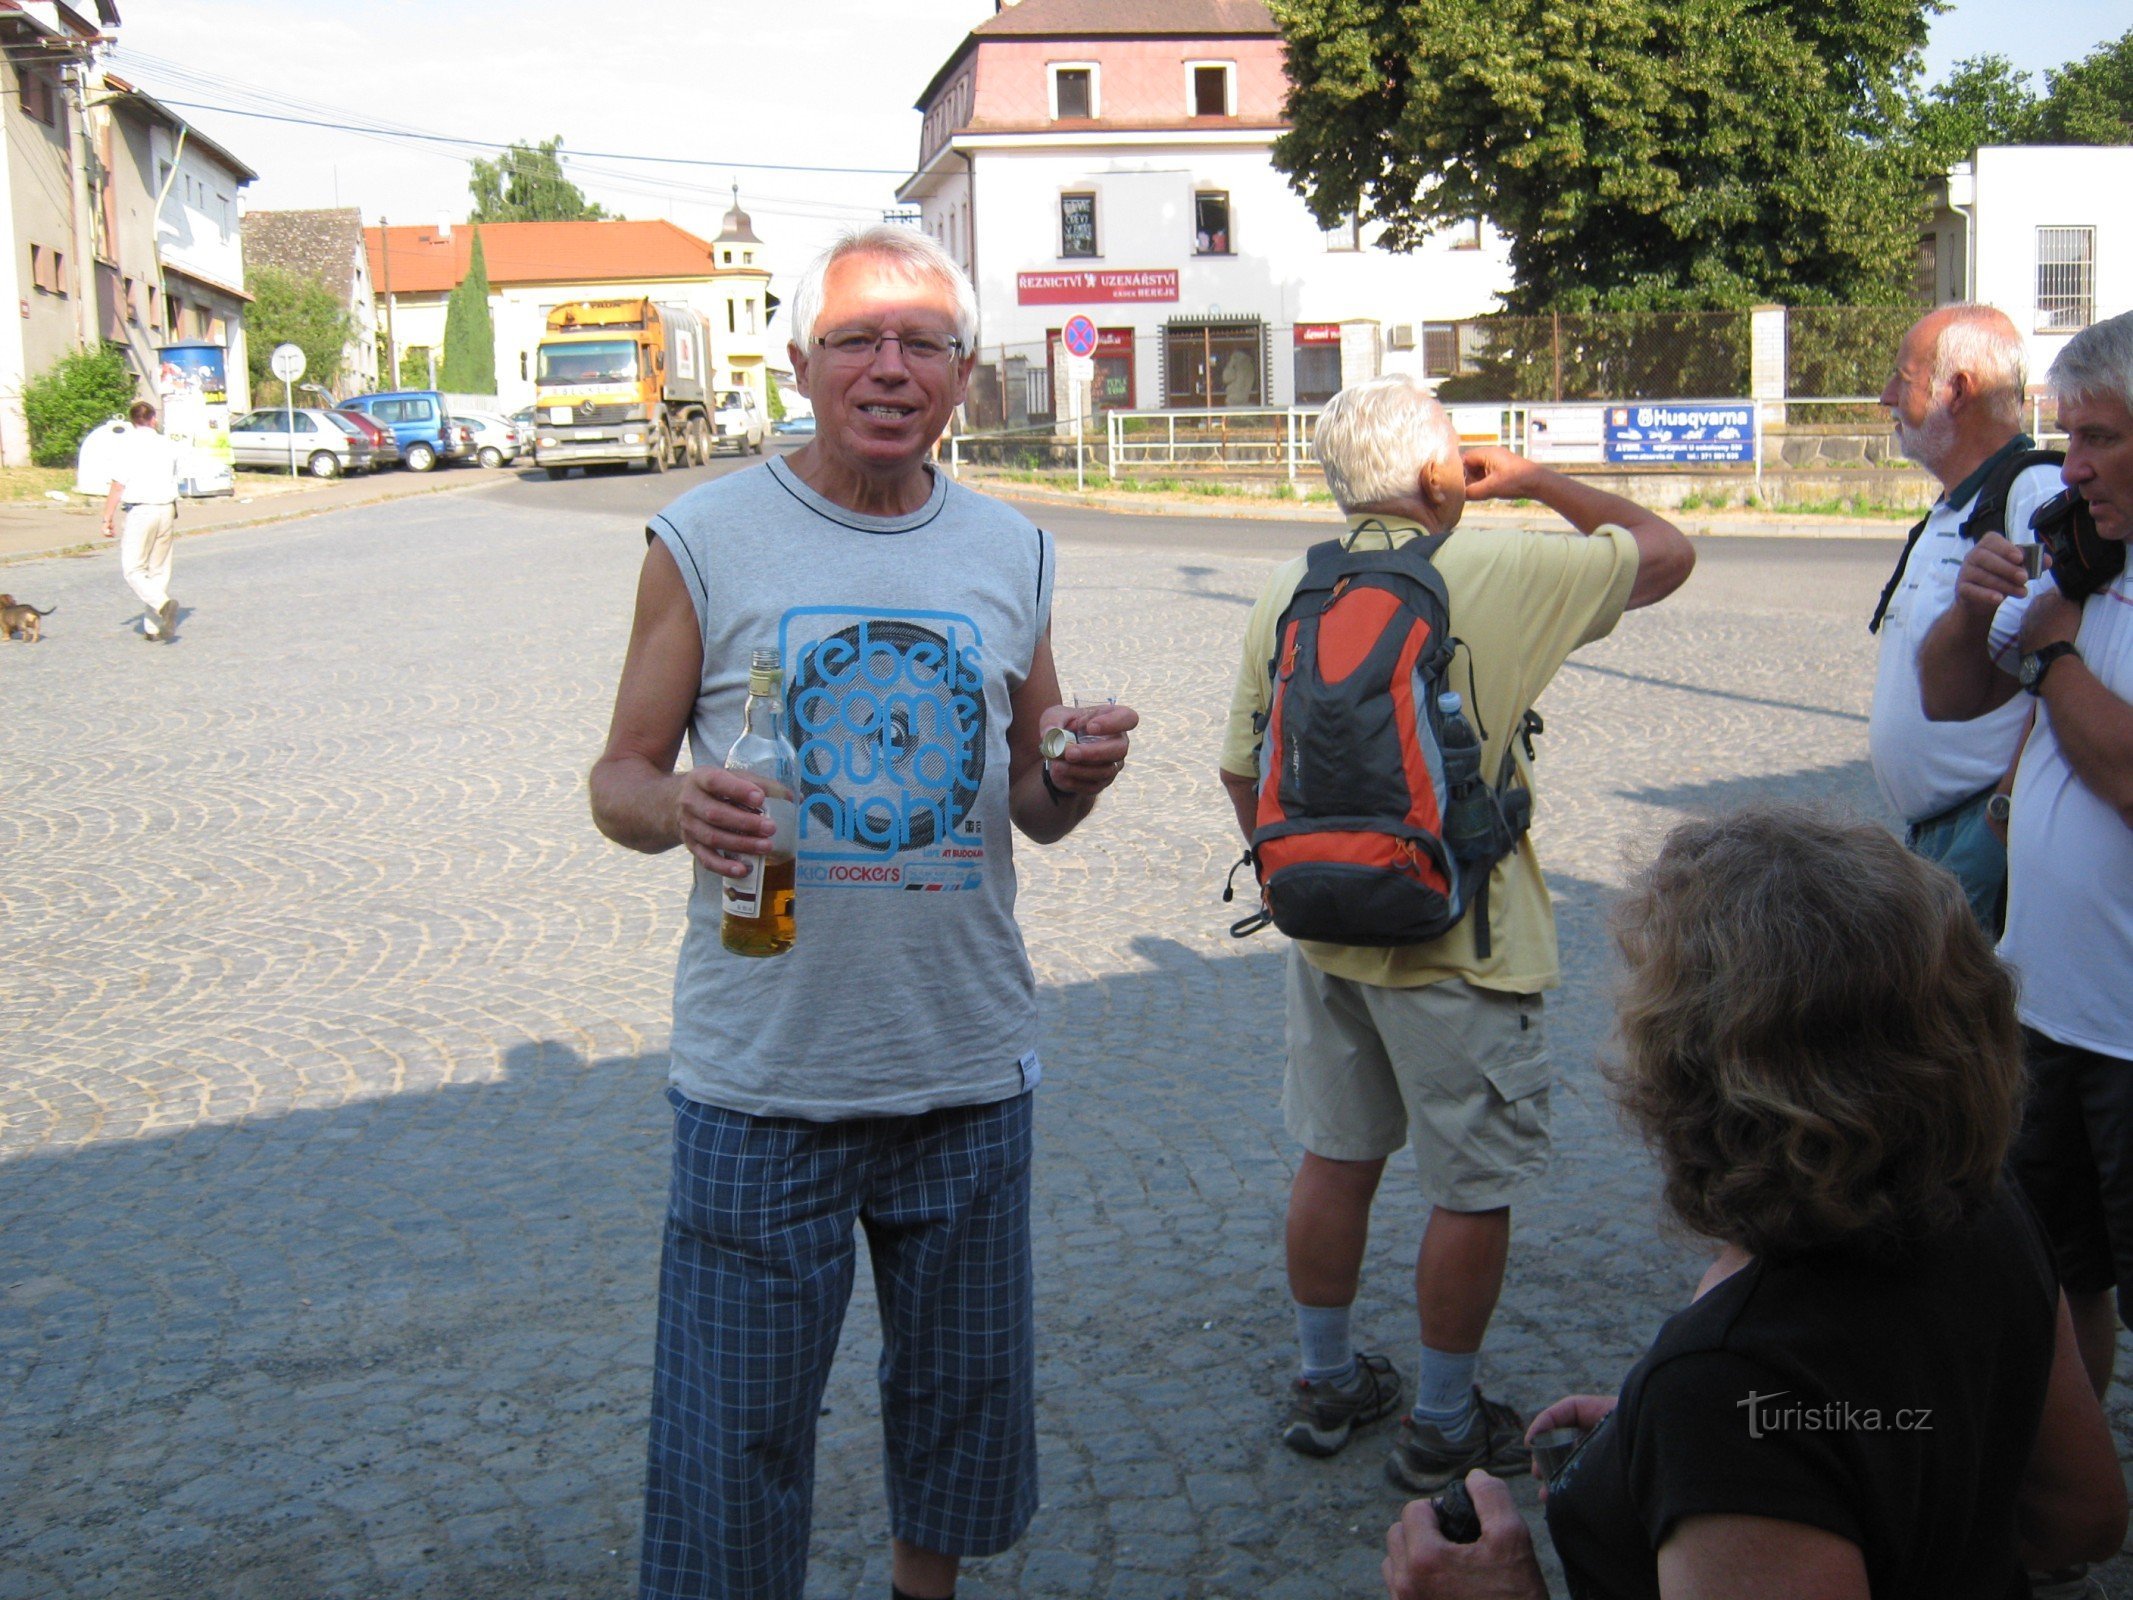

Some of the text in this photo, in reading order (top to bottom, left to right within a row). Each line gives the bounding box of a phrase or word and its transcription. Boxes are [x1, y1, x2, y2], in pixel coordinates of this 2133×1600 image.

[1019, 272, 1176, 289] ŘEZNICTVÍ UZENÁŘSTVÍ
[1654, 408, 1748, 429] Husqvarna
[795, 620, 985, 693] rebels
[794, 687, 979, 738] come
[800, 736, 980, 792] out at
[799, 788, 983, 860] night
